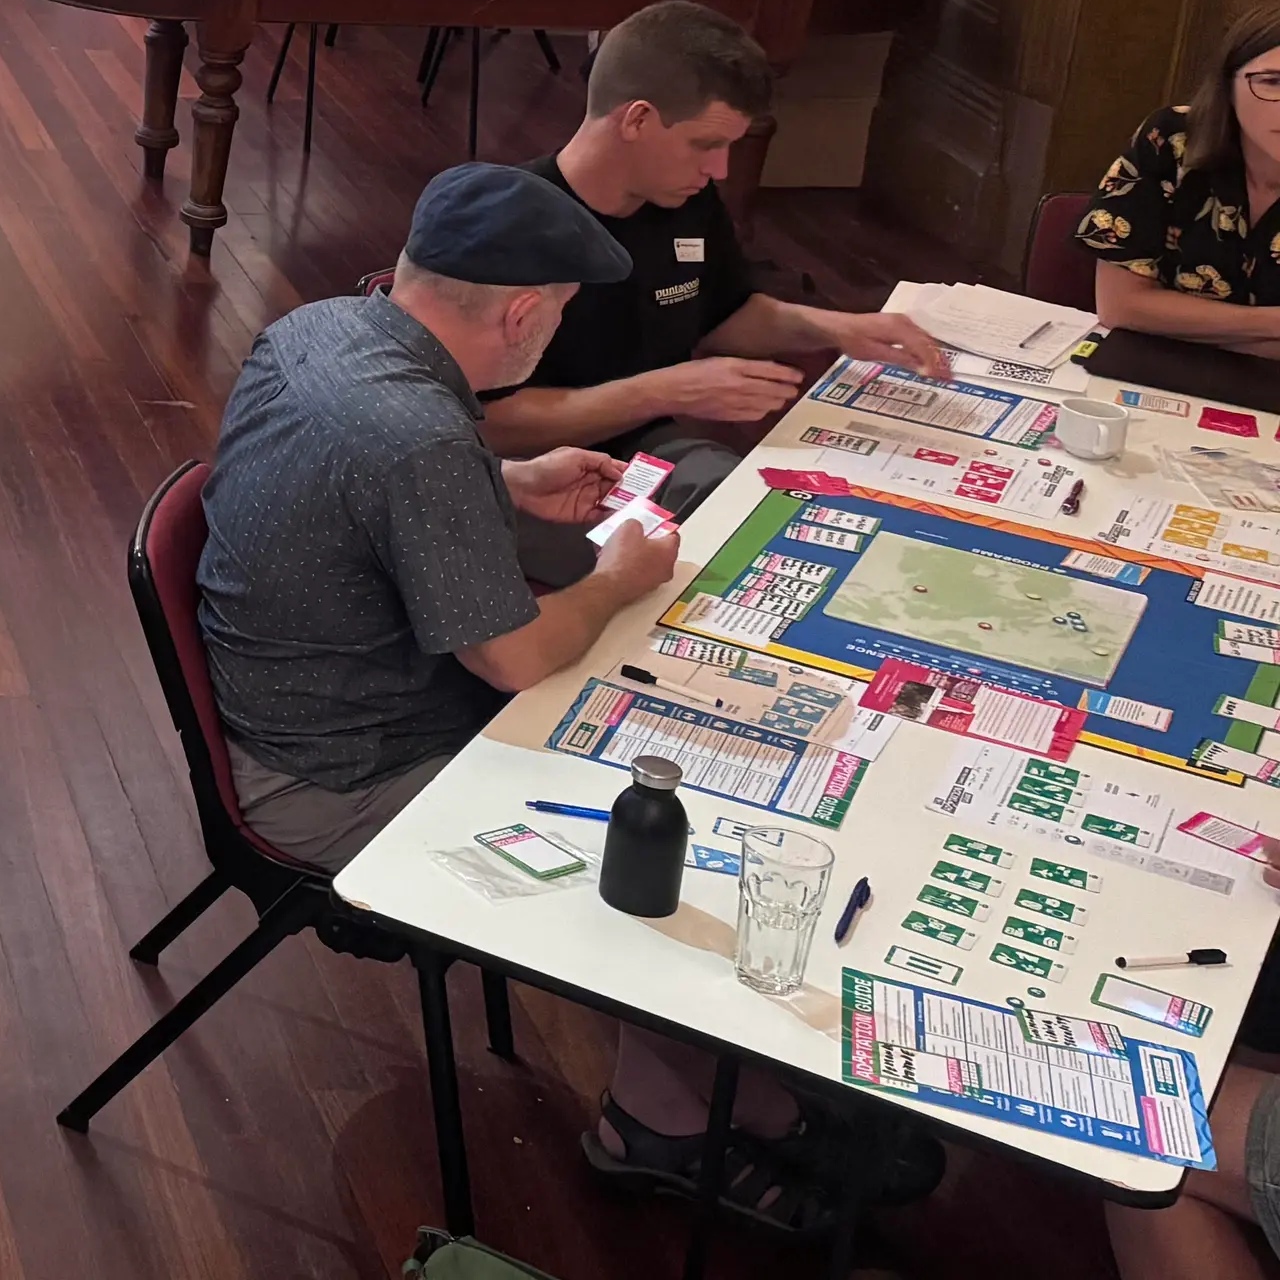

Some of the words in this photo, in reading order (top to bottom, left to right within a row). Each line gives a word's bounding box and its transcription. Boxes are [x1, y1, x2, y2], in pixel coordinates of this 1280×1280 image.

[813, 796, 839, 821] GUIDE
[854, 976, 873, 1013] GUIDE
[852, 1013, 874, 1081] ADAPTATION
